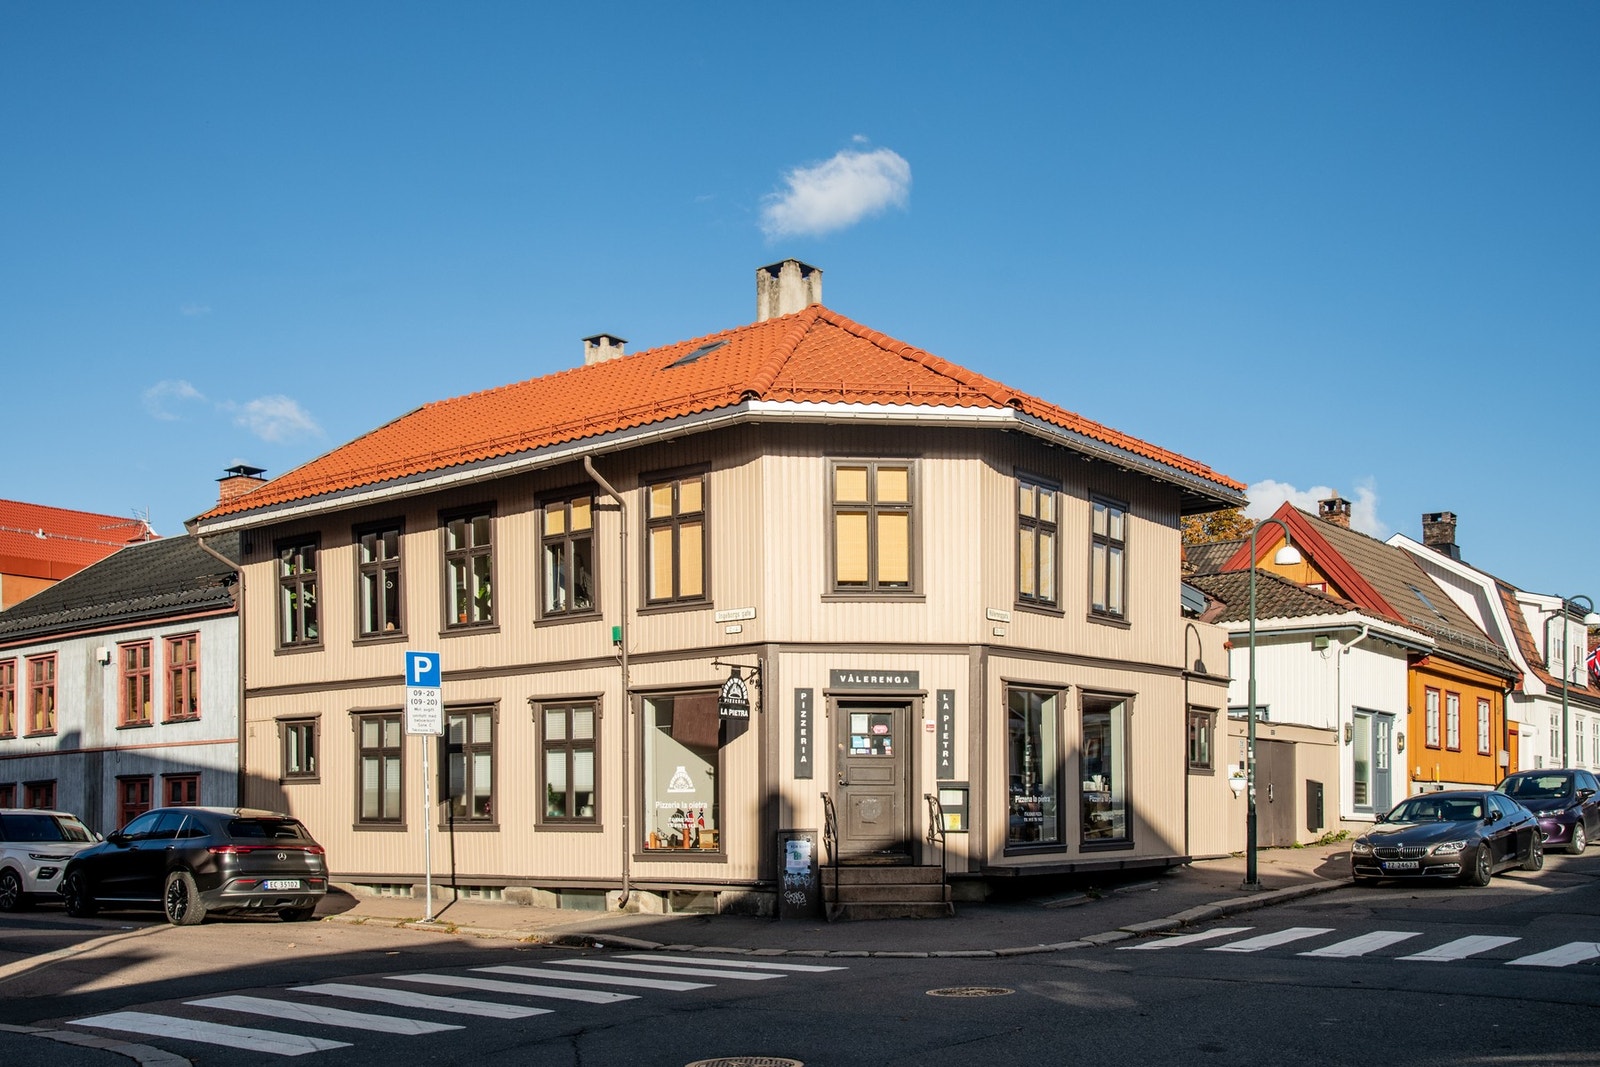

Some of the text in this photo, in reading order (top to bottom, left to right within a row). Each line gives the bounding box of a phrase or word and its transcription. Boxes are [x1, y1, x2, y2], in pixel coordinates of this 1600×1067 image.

[413, 656, 433, 683] P
[840, 674, 910, 684] VÅLERENGA
[720, 708, 749, 717] LA PIETRA
[942, 694, 950, 767] LA PIETRA
[655, 801, 680, 809] Pizzeria
[681, 801, 688, 809] la
